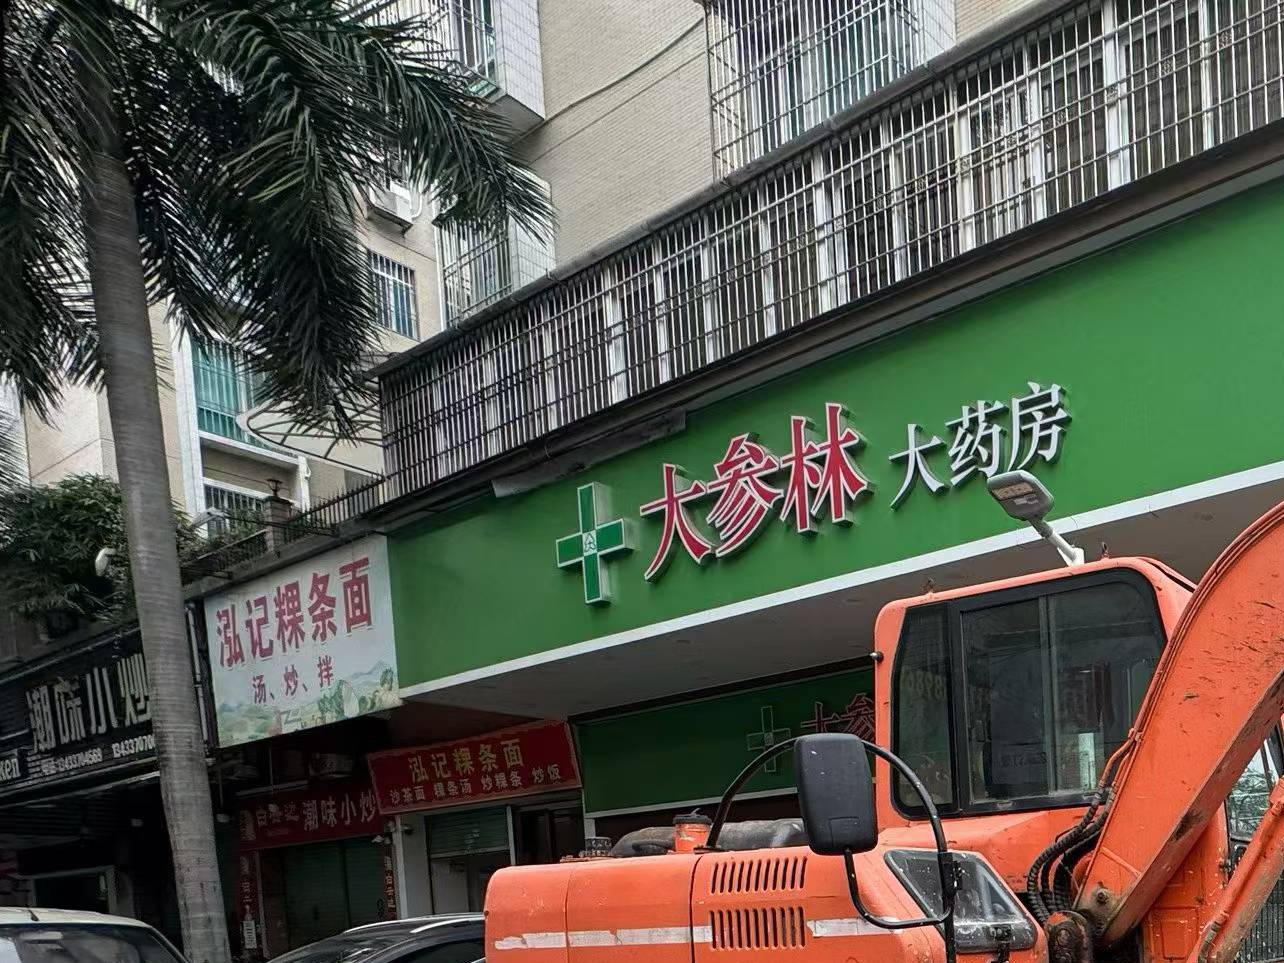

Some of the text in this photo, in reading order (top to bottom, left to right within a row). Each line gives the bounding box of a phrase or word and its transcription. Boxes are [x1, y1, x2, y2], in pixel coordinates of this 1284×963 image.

[640, 381, 1068, 581] 大参林 大药房
[216, 556, 373, 668] 泓记粿条面
[408, 738, 524, 783] 泓记粿条面
